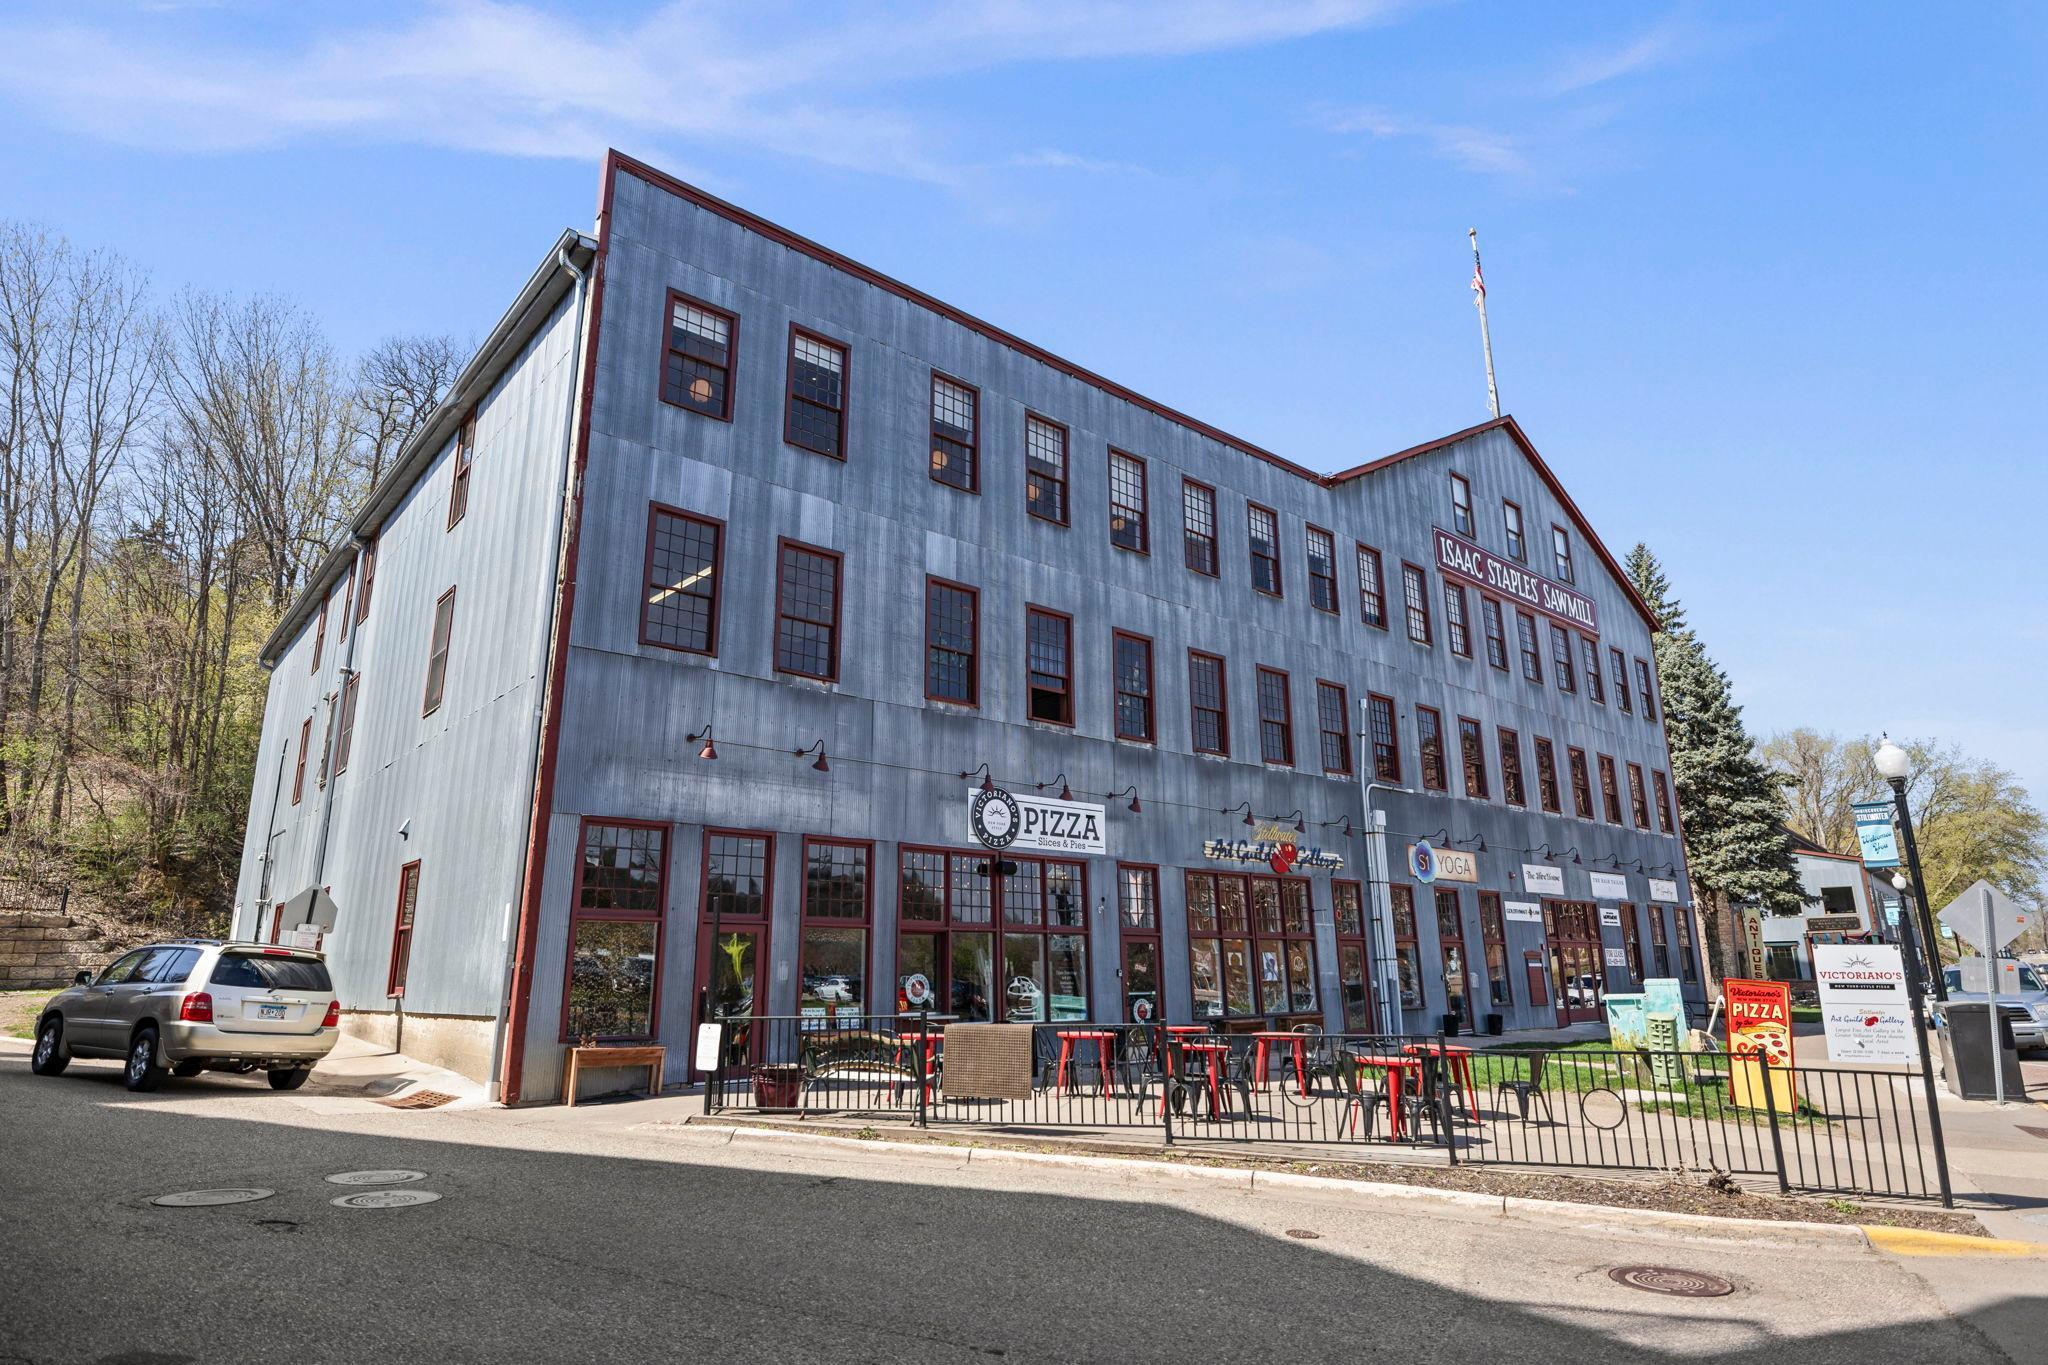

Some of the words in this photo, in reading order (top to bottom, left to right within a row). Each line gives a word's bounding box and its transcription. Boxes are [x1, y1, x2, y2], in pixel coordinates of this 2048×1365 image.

[1440, 537, 1483, 579] ISAAC
[1487, 559, 1539, 604] STAPLES'
[1543, 583, 1594, 626] SAWMILL
[975, 790, 1018, 823] VICTORIANO'S
[1024, 807, 1100, 841] PIZZA
[1856, 813, 1889, 822] STILLWATER
[983, 832, 1012, 846] PIZZA
[1253, 823, 1297, 842] Stillwater
[1038, 837, 1061, 847] Slices
[1070, 841, 1086, 850] Pies
[1873, 842, 1889, 855] You
[1211, 838, 1234, 860] Art
[1237, 839, 1275, 865] Guild
[1296, 845, 1338, 876] Gallery
[1437, 855, 1472, 875] YOGA
[1526, 870, 1535, 880] The
[1749, 917, 1763, 979] ANTIQUES
[1820, 971, 1902, 980] VICTORIANO'S
[1730, 987, 1781, 998] Victoriano's
[1732, 1003, 1783, 1019] PIZZA
[1735, 1020, 1743, 1029] by
[1831, 1014, 1842, 1022] Art
[1844, 1015, 1863, 1023] Guild
[1879, 1015, 1905, 1025] Gallery
